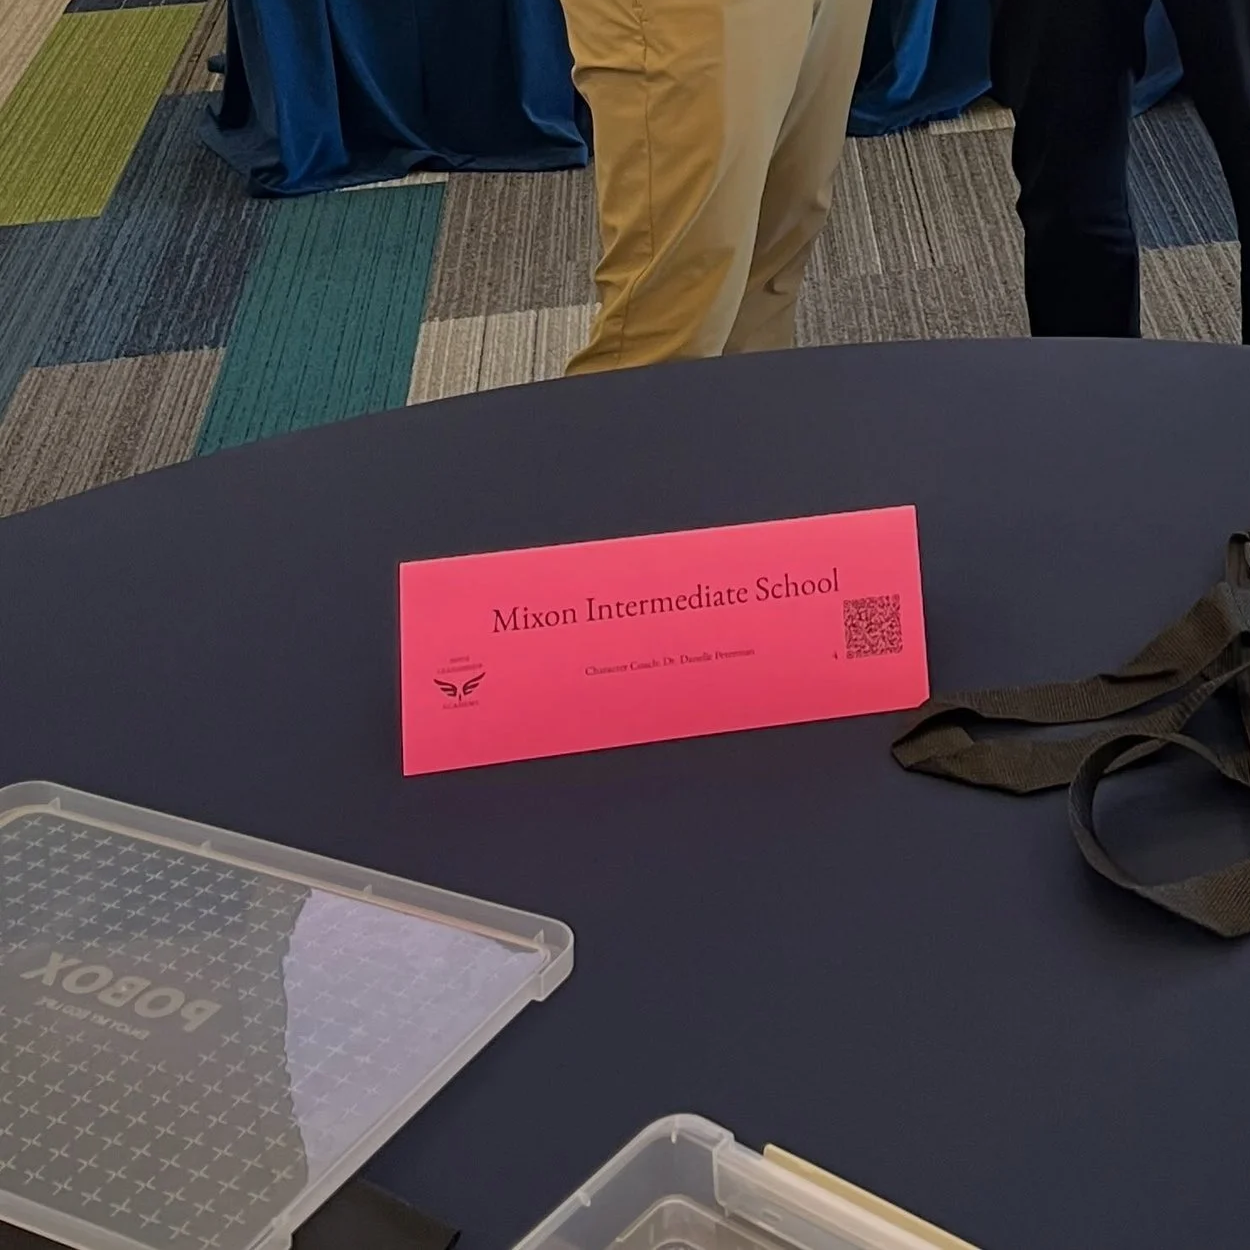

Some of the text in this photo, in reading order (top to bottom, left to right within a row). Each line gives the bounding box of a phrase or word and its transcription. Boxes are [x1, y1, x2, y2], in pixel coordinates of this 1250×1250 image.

[492, 567, 841, 633] Mixon Intermediate School
